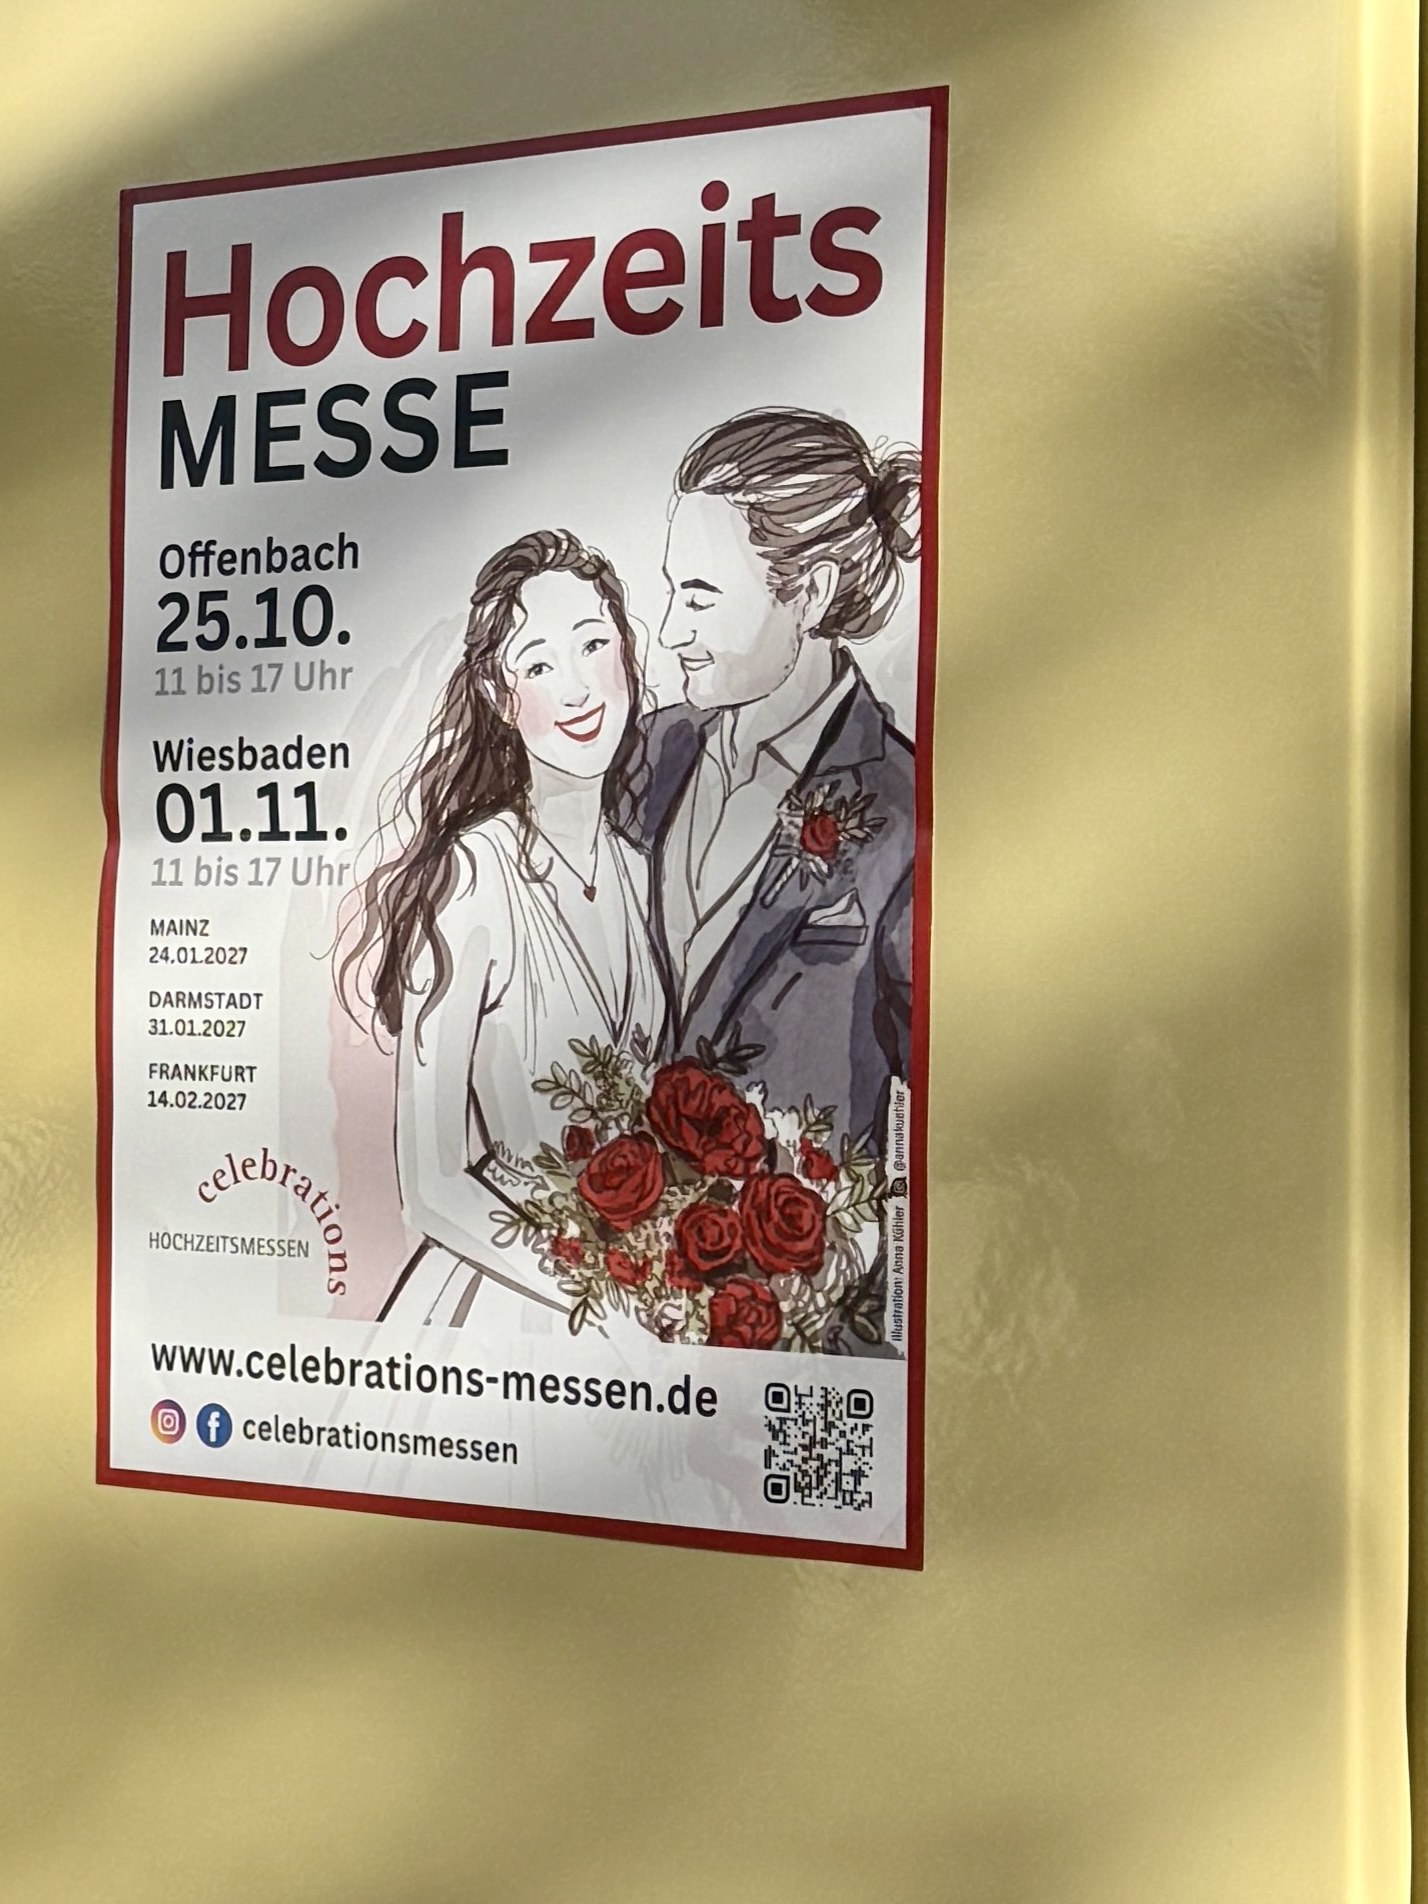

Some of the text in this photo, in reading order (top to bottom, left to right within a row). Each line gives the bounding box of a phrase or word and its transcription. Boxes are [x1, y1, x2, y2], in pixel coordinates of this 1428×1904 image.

[162, 179, 884, 377] Hochzeits
[159, 370, 511, 490] MESSE
[158, 532, 359, 579] Offenbach
[156, 583, 351, 653] 25.10.
[154, 659, 354, 696] 11 bis 17 Uhr
[152, 735, 350, 773] Wiesbaden
[155, 781, 348, 843] 01.11.
[151, 853, 351, 887] 11 bis 17 Uhr
[150, 919, 210, 937] MAINZ
[148, 946, 248, 965] 24.01.2027
[148, 991, 263, 1010] DARMSTADT
[148, 1018, 246, 1038] 31.01.2027
[147, 1062, 257, 1083] FRANKFURT
[146, 1090, 247, 1111] 14.02.2027
[197, 1147, 349, 1296] celebrations
[148, 1231, 310, 1258] HOCHZEITSMESSEN
[151, 1343, 718, 1418] www.celebrations-messen.de
[242, 1413, 518, 1465] celebrationsmessen
